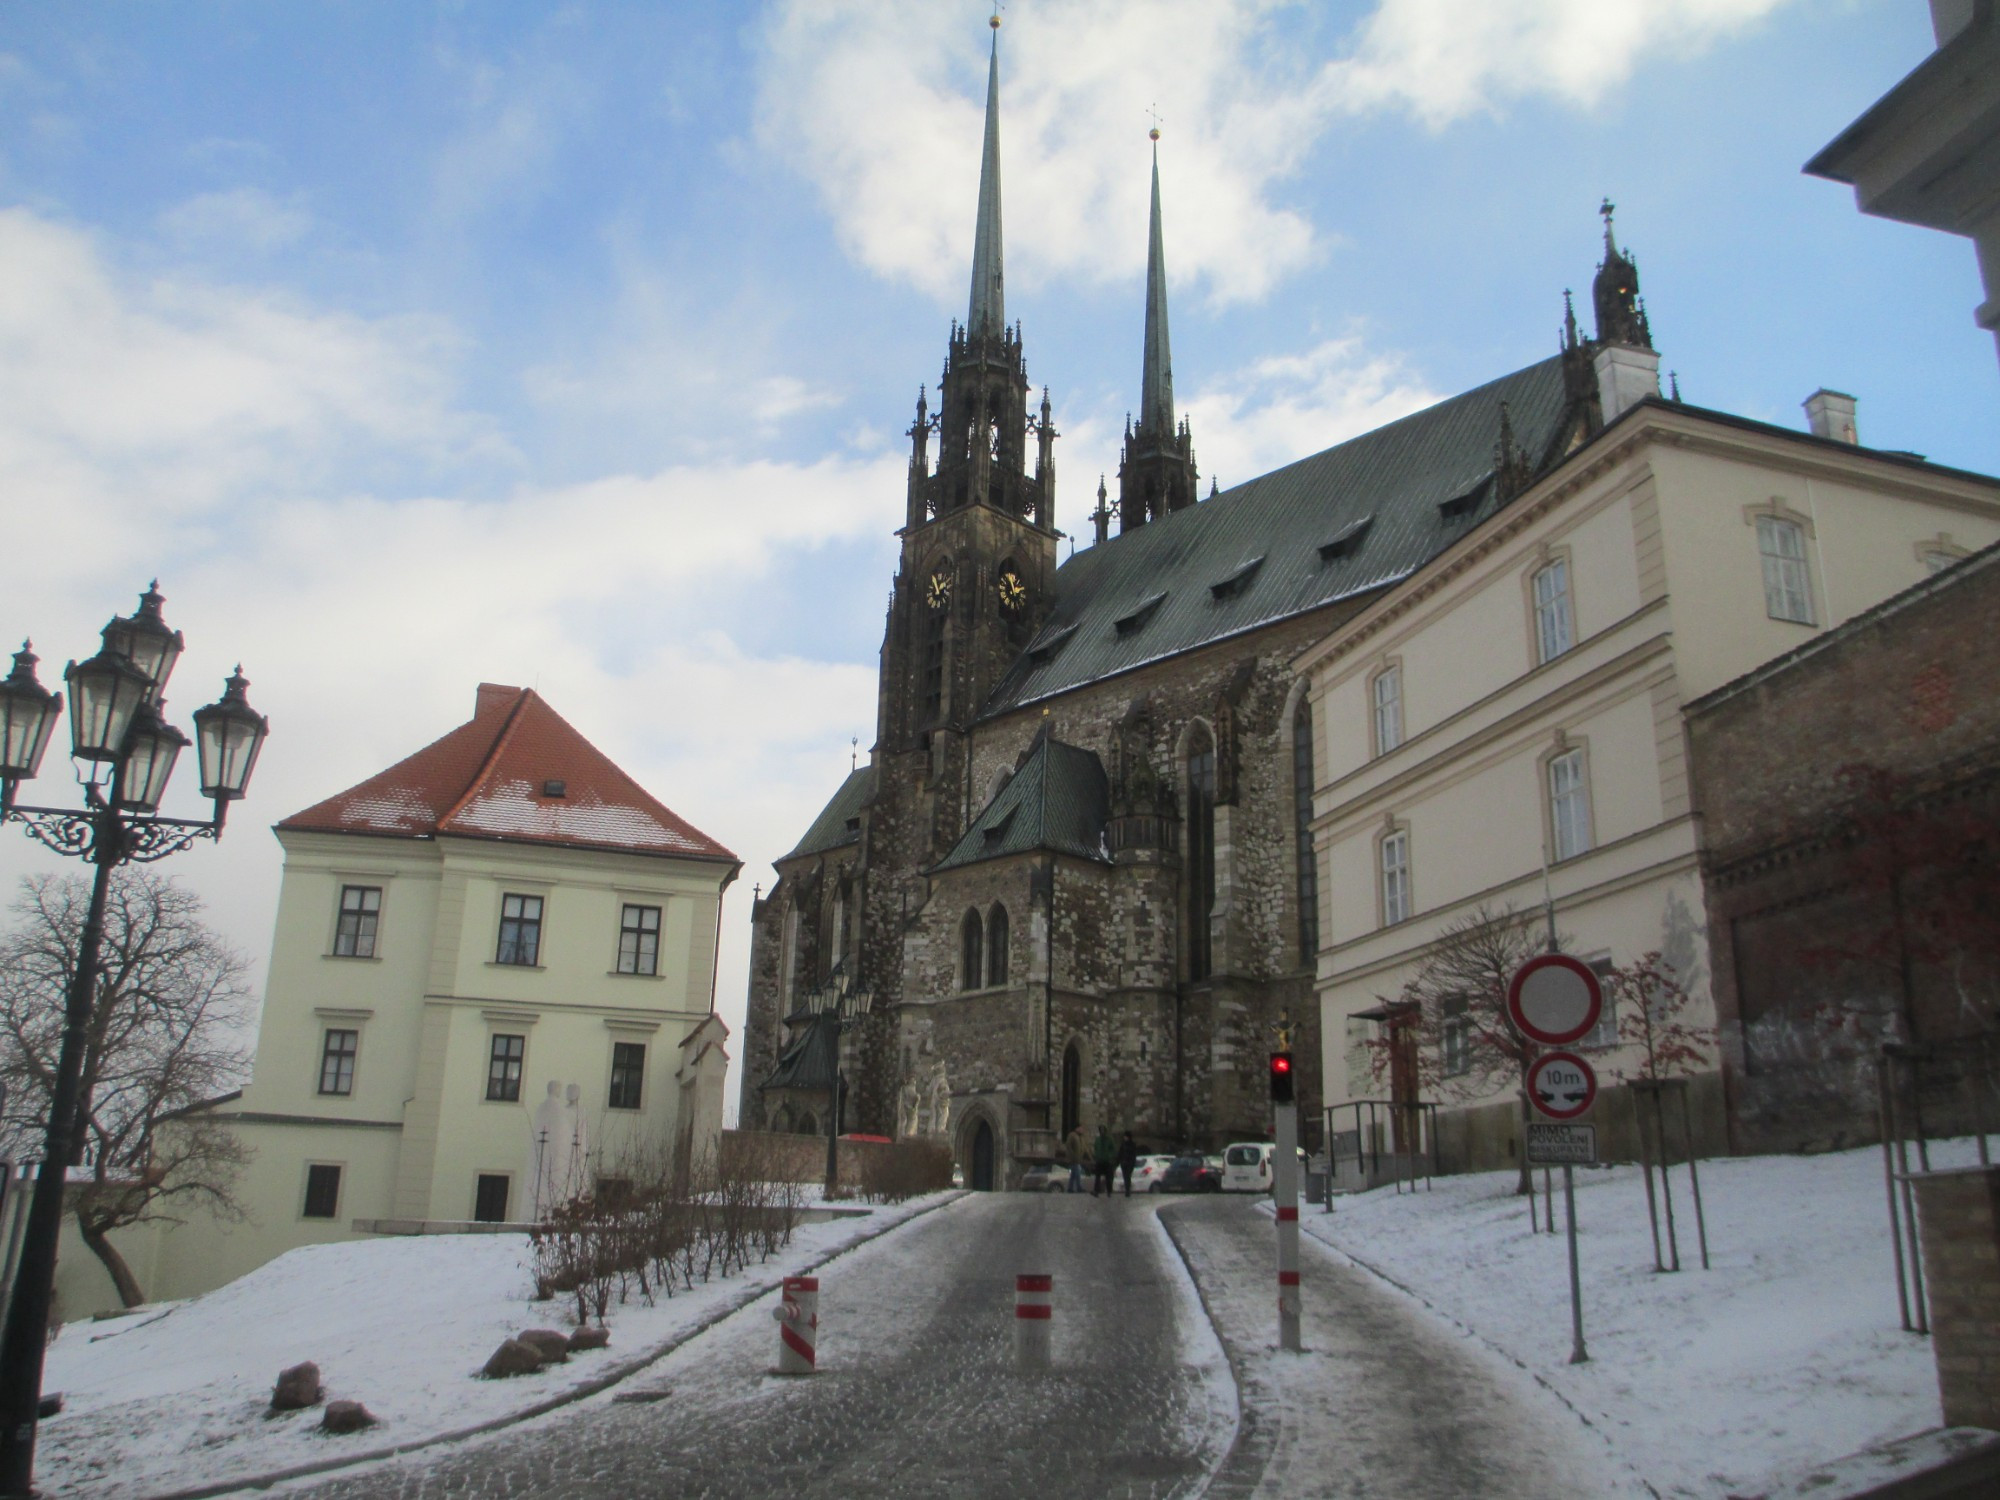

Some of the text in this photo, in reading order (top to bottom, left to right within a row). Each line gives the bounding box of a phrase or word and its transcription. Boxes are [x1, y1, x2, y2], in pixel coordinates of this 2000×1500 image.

[1546, 1070, 1580, 1085] 10 m
[1530, 1125, 1571, 1135] MIMO
